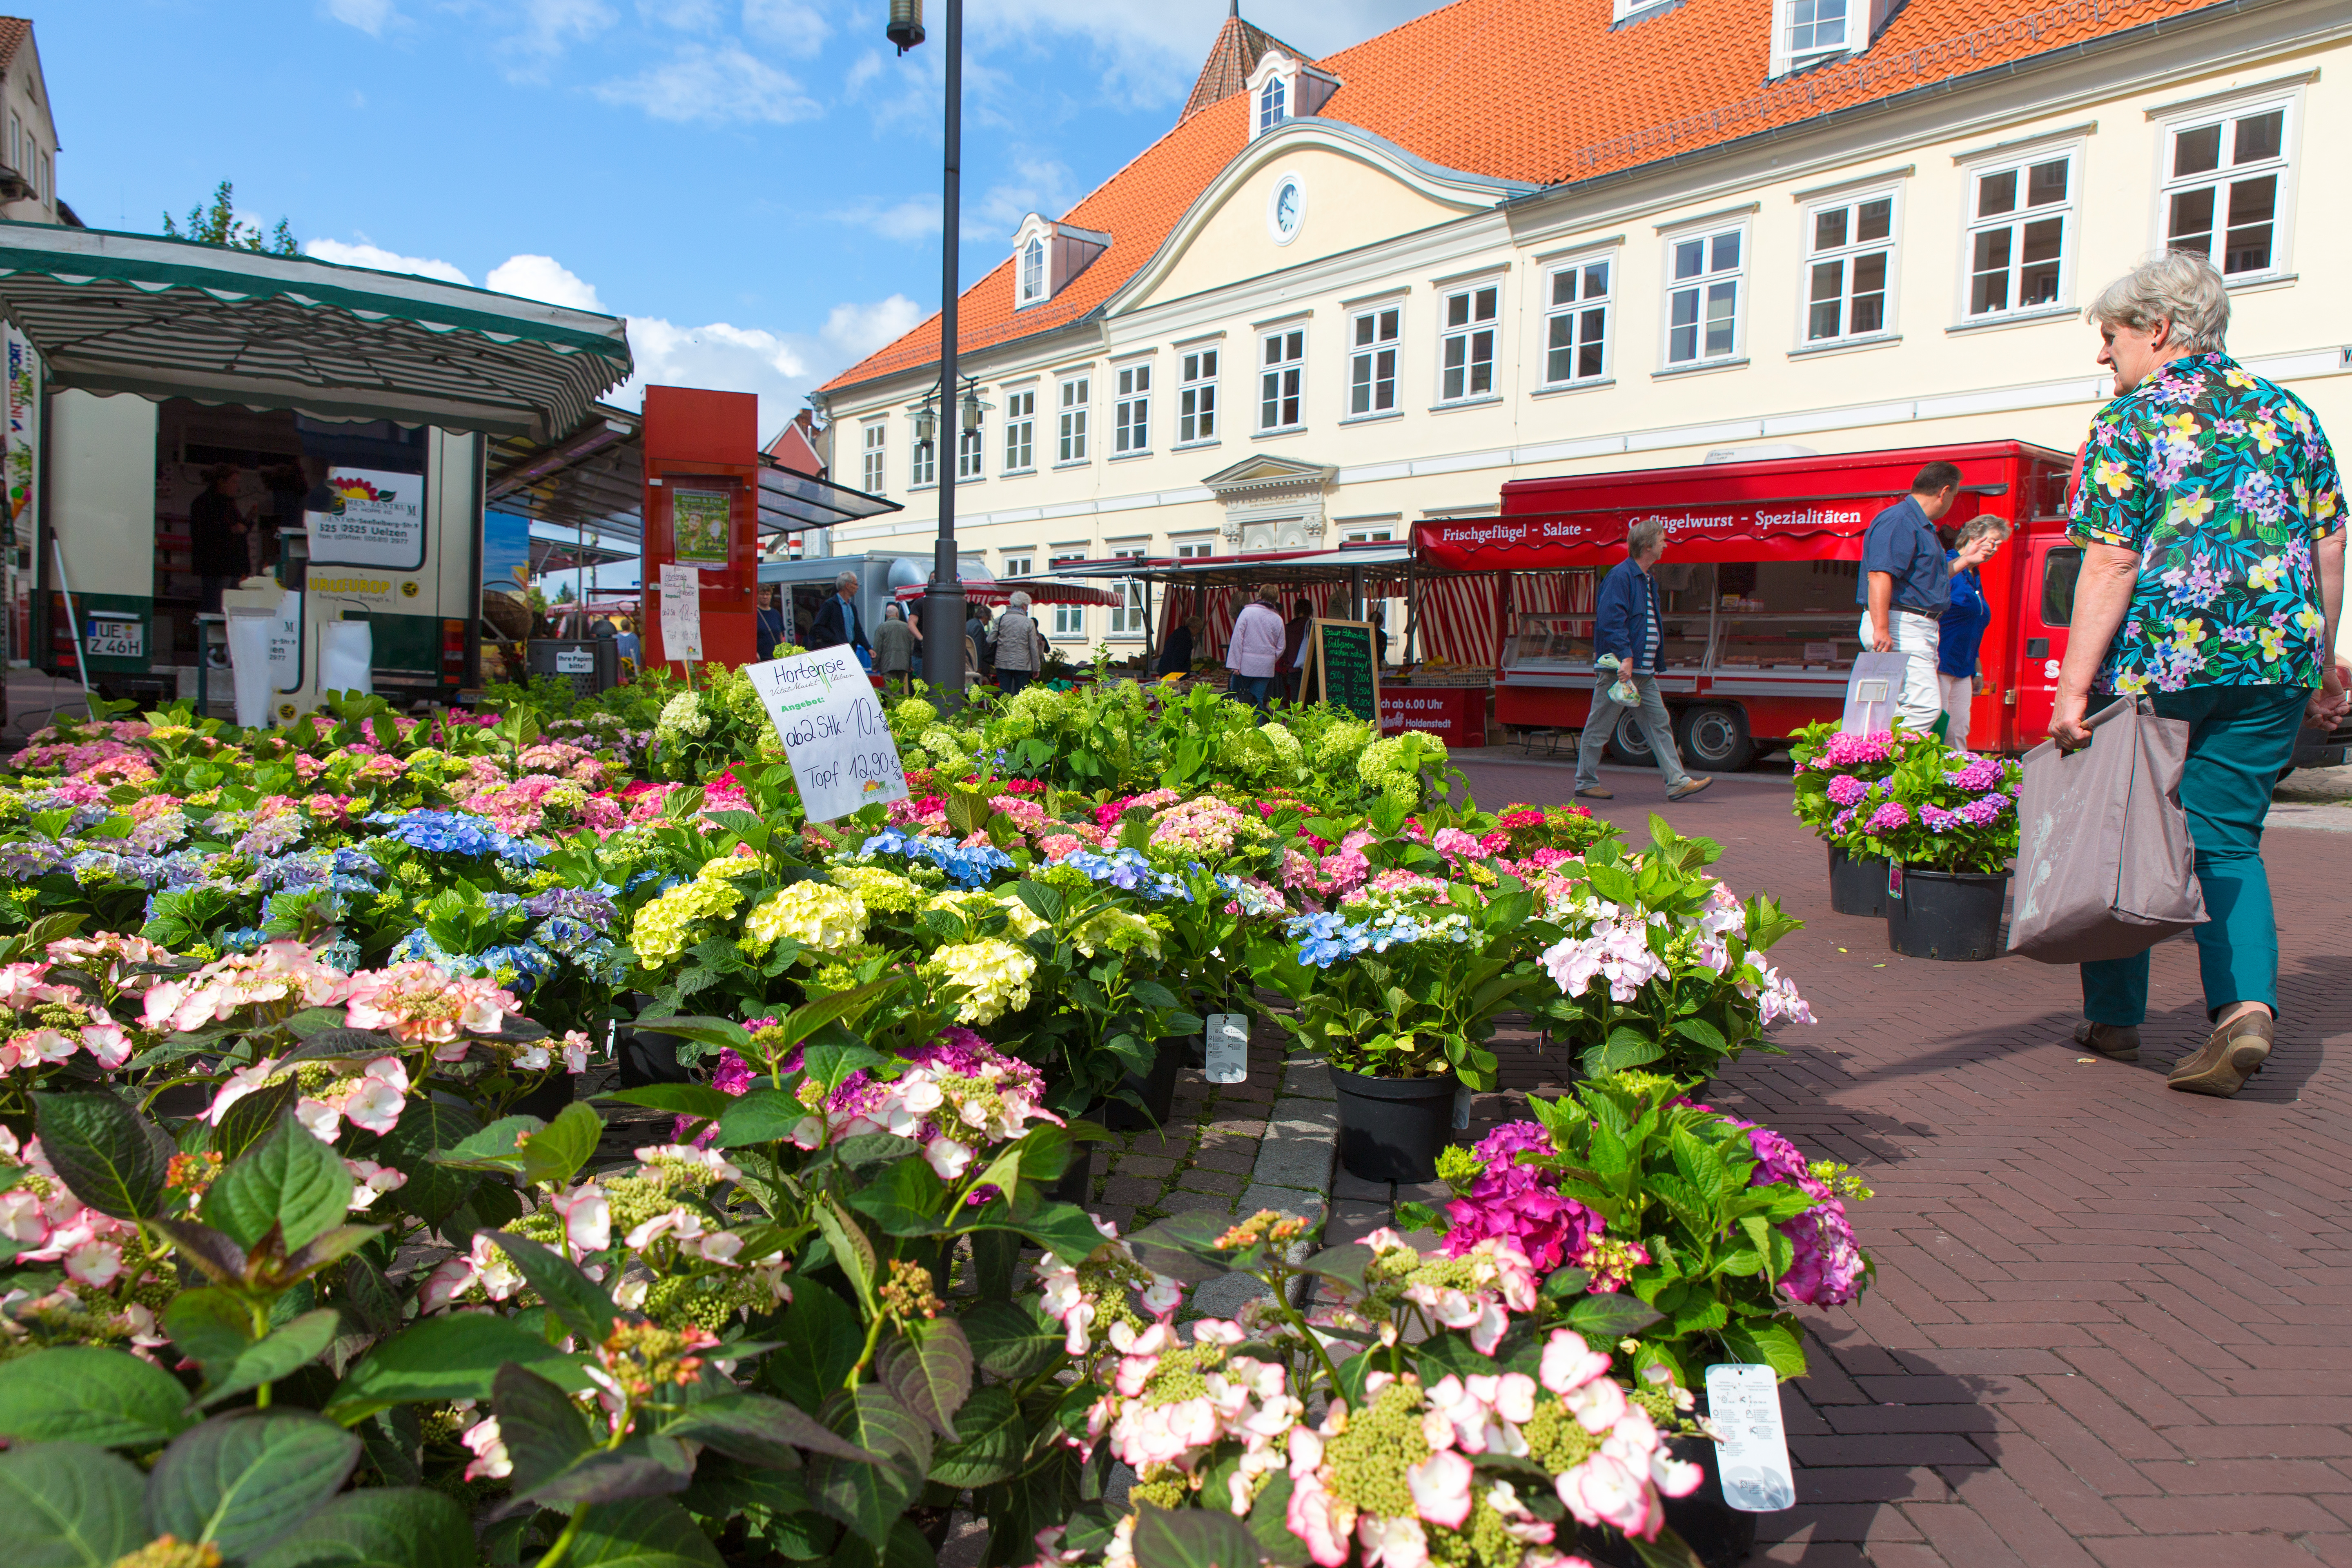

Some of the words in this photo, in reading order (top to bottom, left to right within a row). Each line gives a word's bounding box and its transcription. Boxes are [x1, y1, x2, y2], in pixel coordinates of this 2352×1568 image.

[2344, 350, 2352, 362] V
[1628, 513, 1733, 534] Gflügelwurst
[1755, 508, 1861, 530] Spezialitäten
[371, 527, 408, 537] Uelzen
[1443, 523, 1526, 543] Frischgeflügel
[1543, 521, 1581, 537] Salate
[786, 599, 794, 646] FISCH
[99, 624, 122, 638] UE
[90, 638, 102, 653] Z
[106, 639, 141, 655] 46H
[1328, 648, 1349, 656] machen
[774, 658, 846, 685] Hortensie
[830, 673, 855, 682] Uelzen
[1329, 670, 1345, 683] 500g
[781, 697, 825, 713] Angebot:
[1392, 698, 1404, 709] ab
[1405, 698, 1425, 709] 6.00
[1427, 699, 1443, 709] Uhr
[817, 715, 845, 738] Stk.
[1405, 718, 1452, 728] Holdenstedt
[803, 761, 839, 790] Topf
[861, 784, 897, 800] BLUMEN-ZENTRUM
